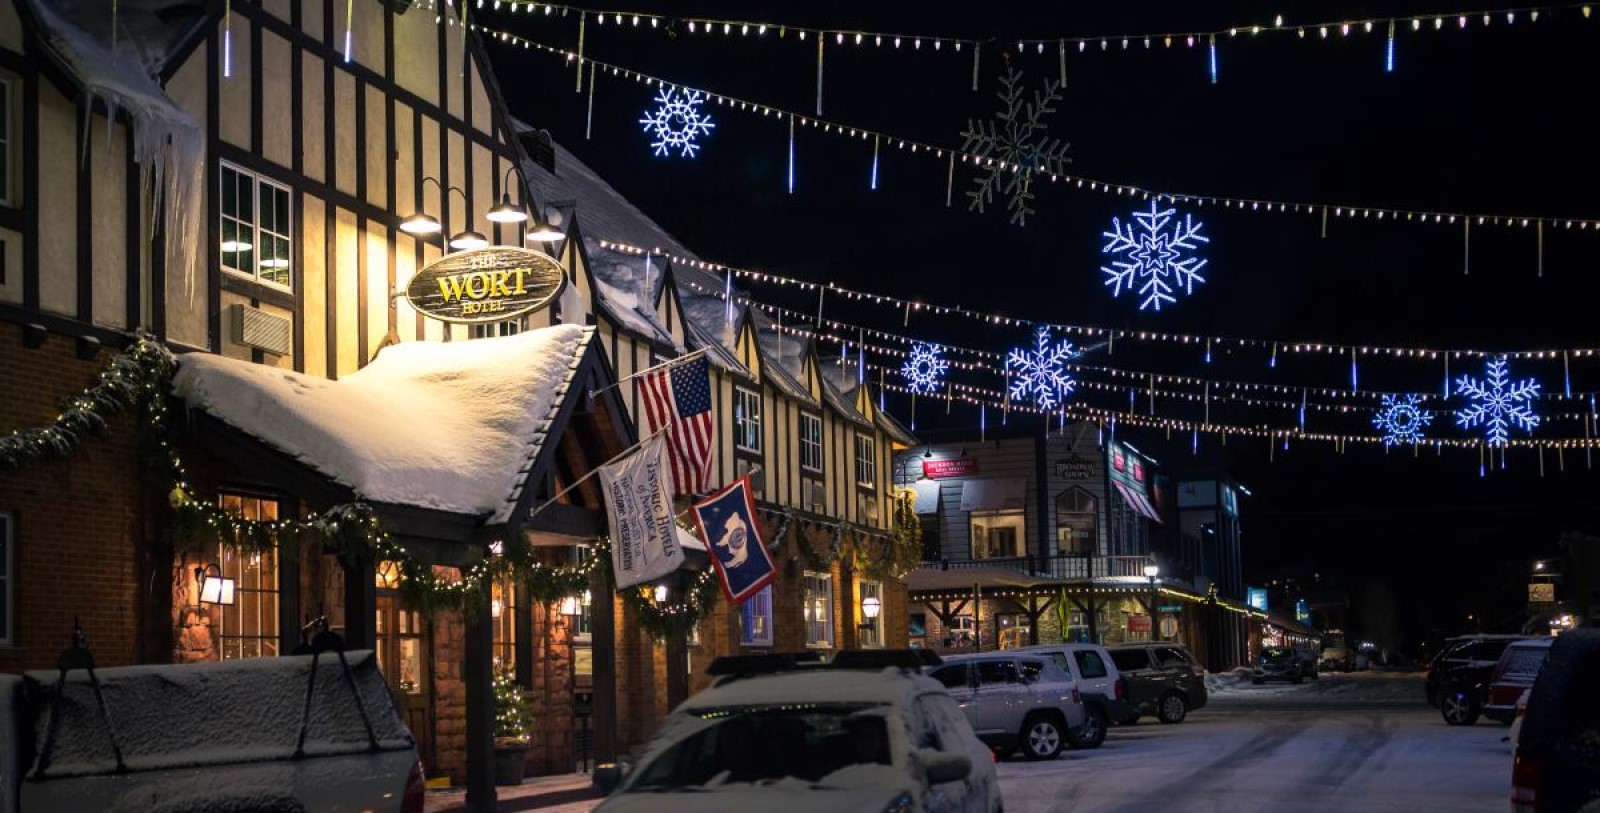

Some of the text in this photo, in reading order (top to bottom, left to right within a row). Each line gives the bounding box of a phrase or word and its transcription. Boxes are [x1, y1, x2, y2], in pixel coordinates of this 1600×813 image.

[470, 254, 498, 269] THE
[436, 267, 532, 303] WORT
[462, 300, 505, 315] HOTEL
